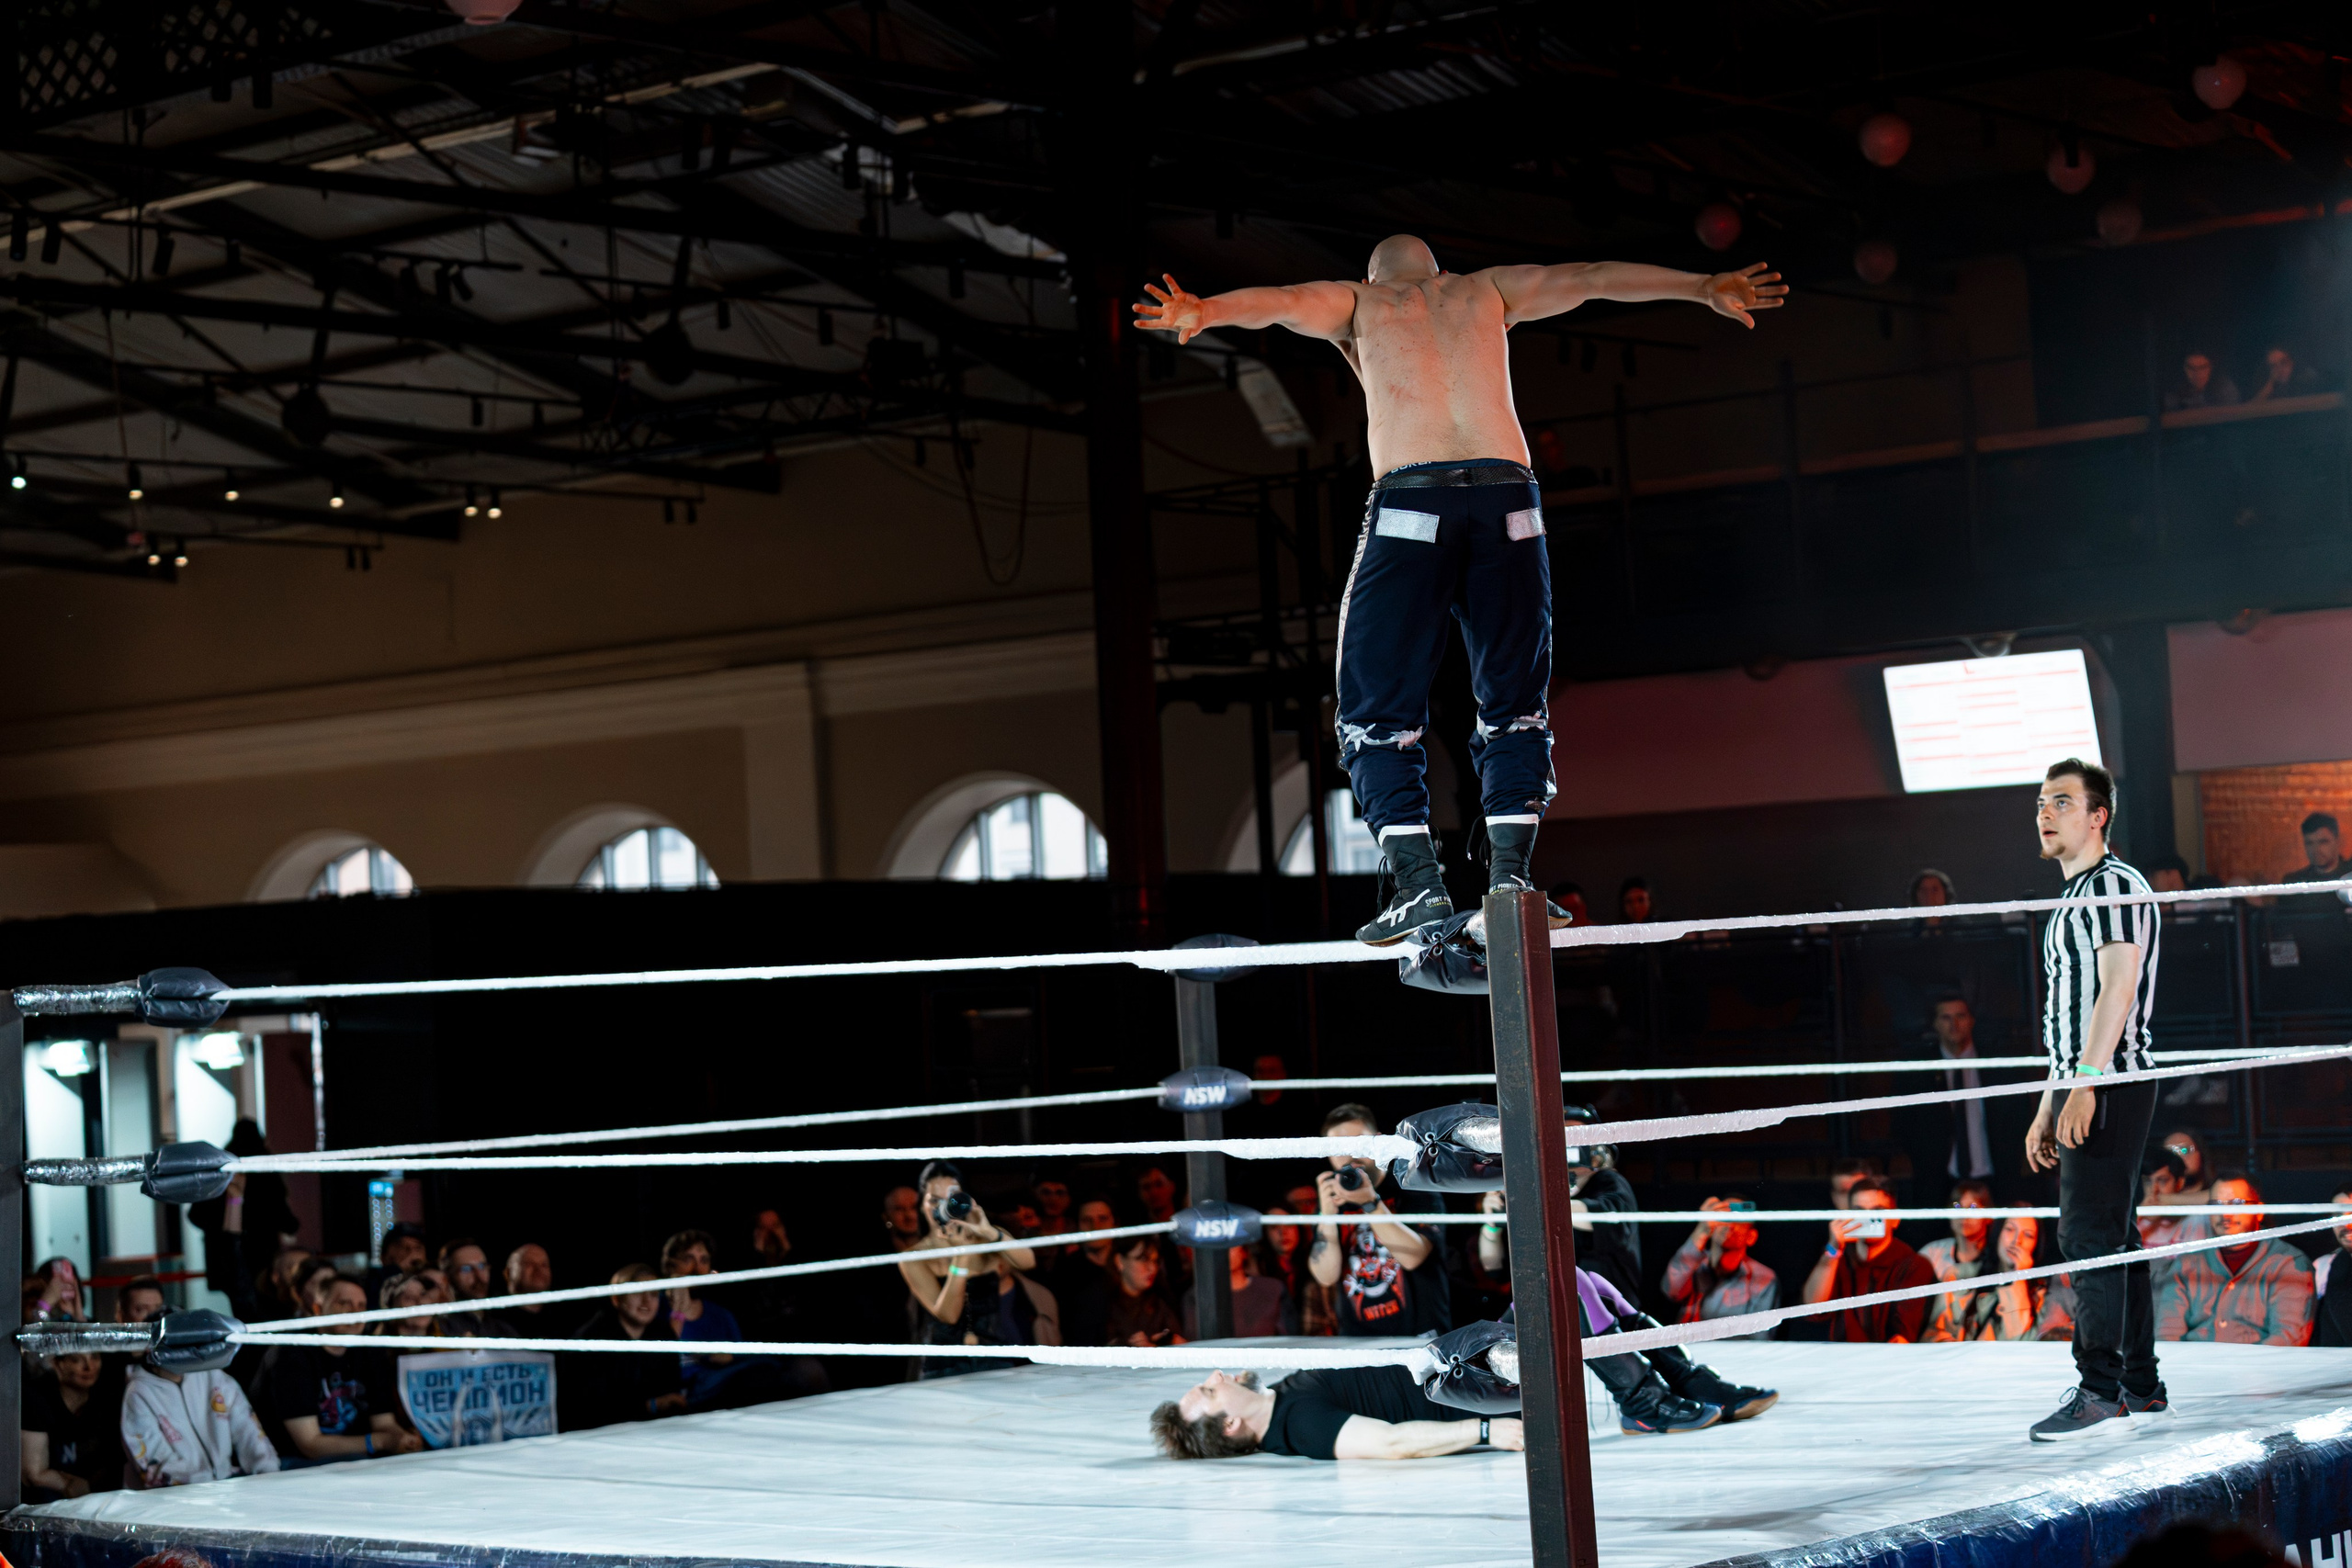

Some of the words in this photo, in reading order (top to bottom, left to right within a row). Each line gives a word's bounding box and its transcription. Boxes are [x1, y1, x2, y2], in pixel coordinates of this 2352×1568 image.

[1425, 896, 1442, 908] SPORT
[1183, 1085, 1227, 1105] NSW
[1194, 1219, 1239, 1238] NSW
[424, 1371, 454, 1388] ОН
